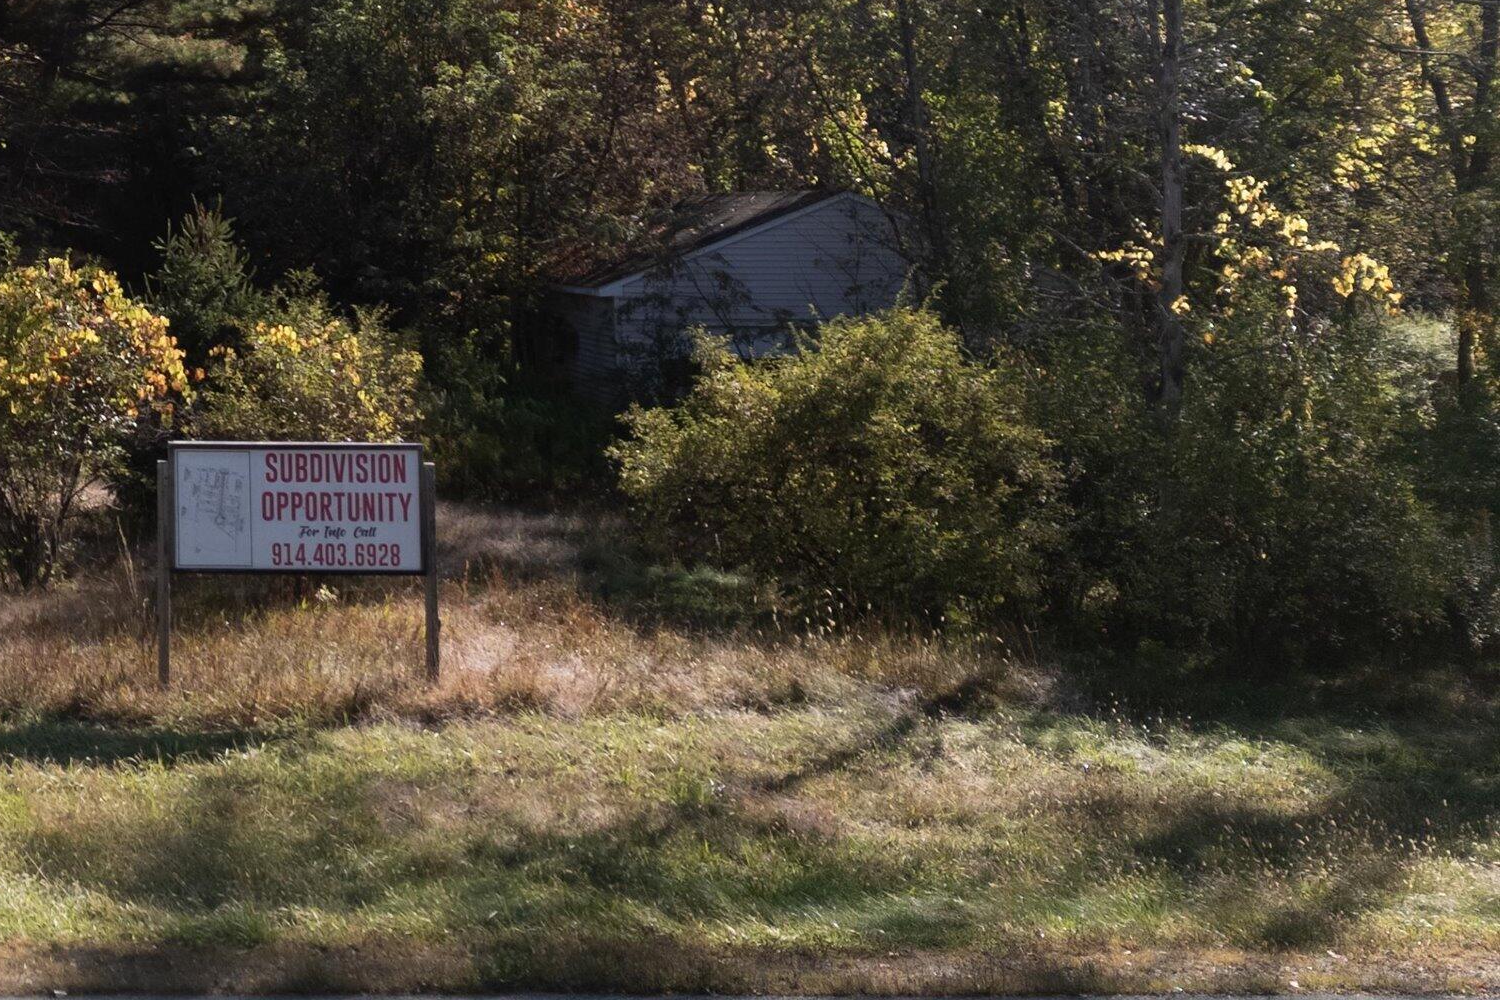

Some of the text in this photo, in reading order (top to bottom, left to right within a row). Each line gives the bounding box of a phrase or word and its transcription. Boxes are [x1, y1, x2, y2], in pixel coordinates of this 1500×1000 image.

[265, 453, 407, 483] SUBDIVISION
[261, 491, 412, 522] OPPORTUNITY
[299, 526, 377, 539] For Info Call
[271, 543, 401, 566] 914.403.6928
